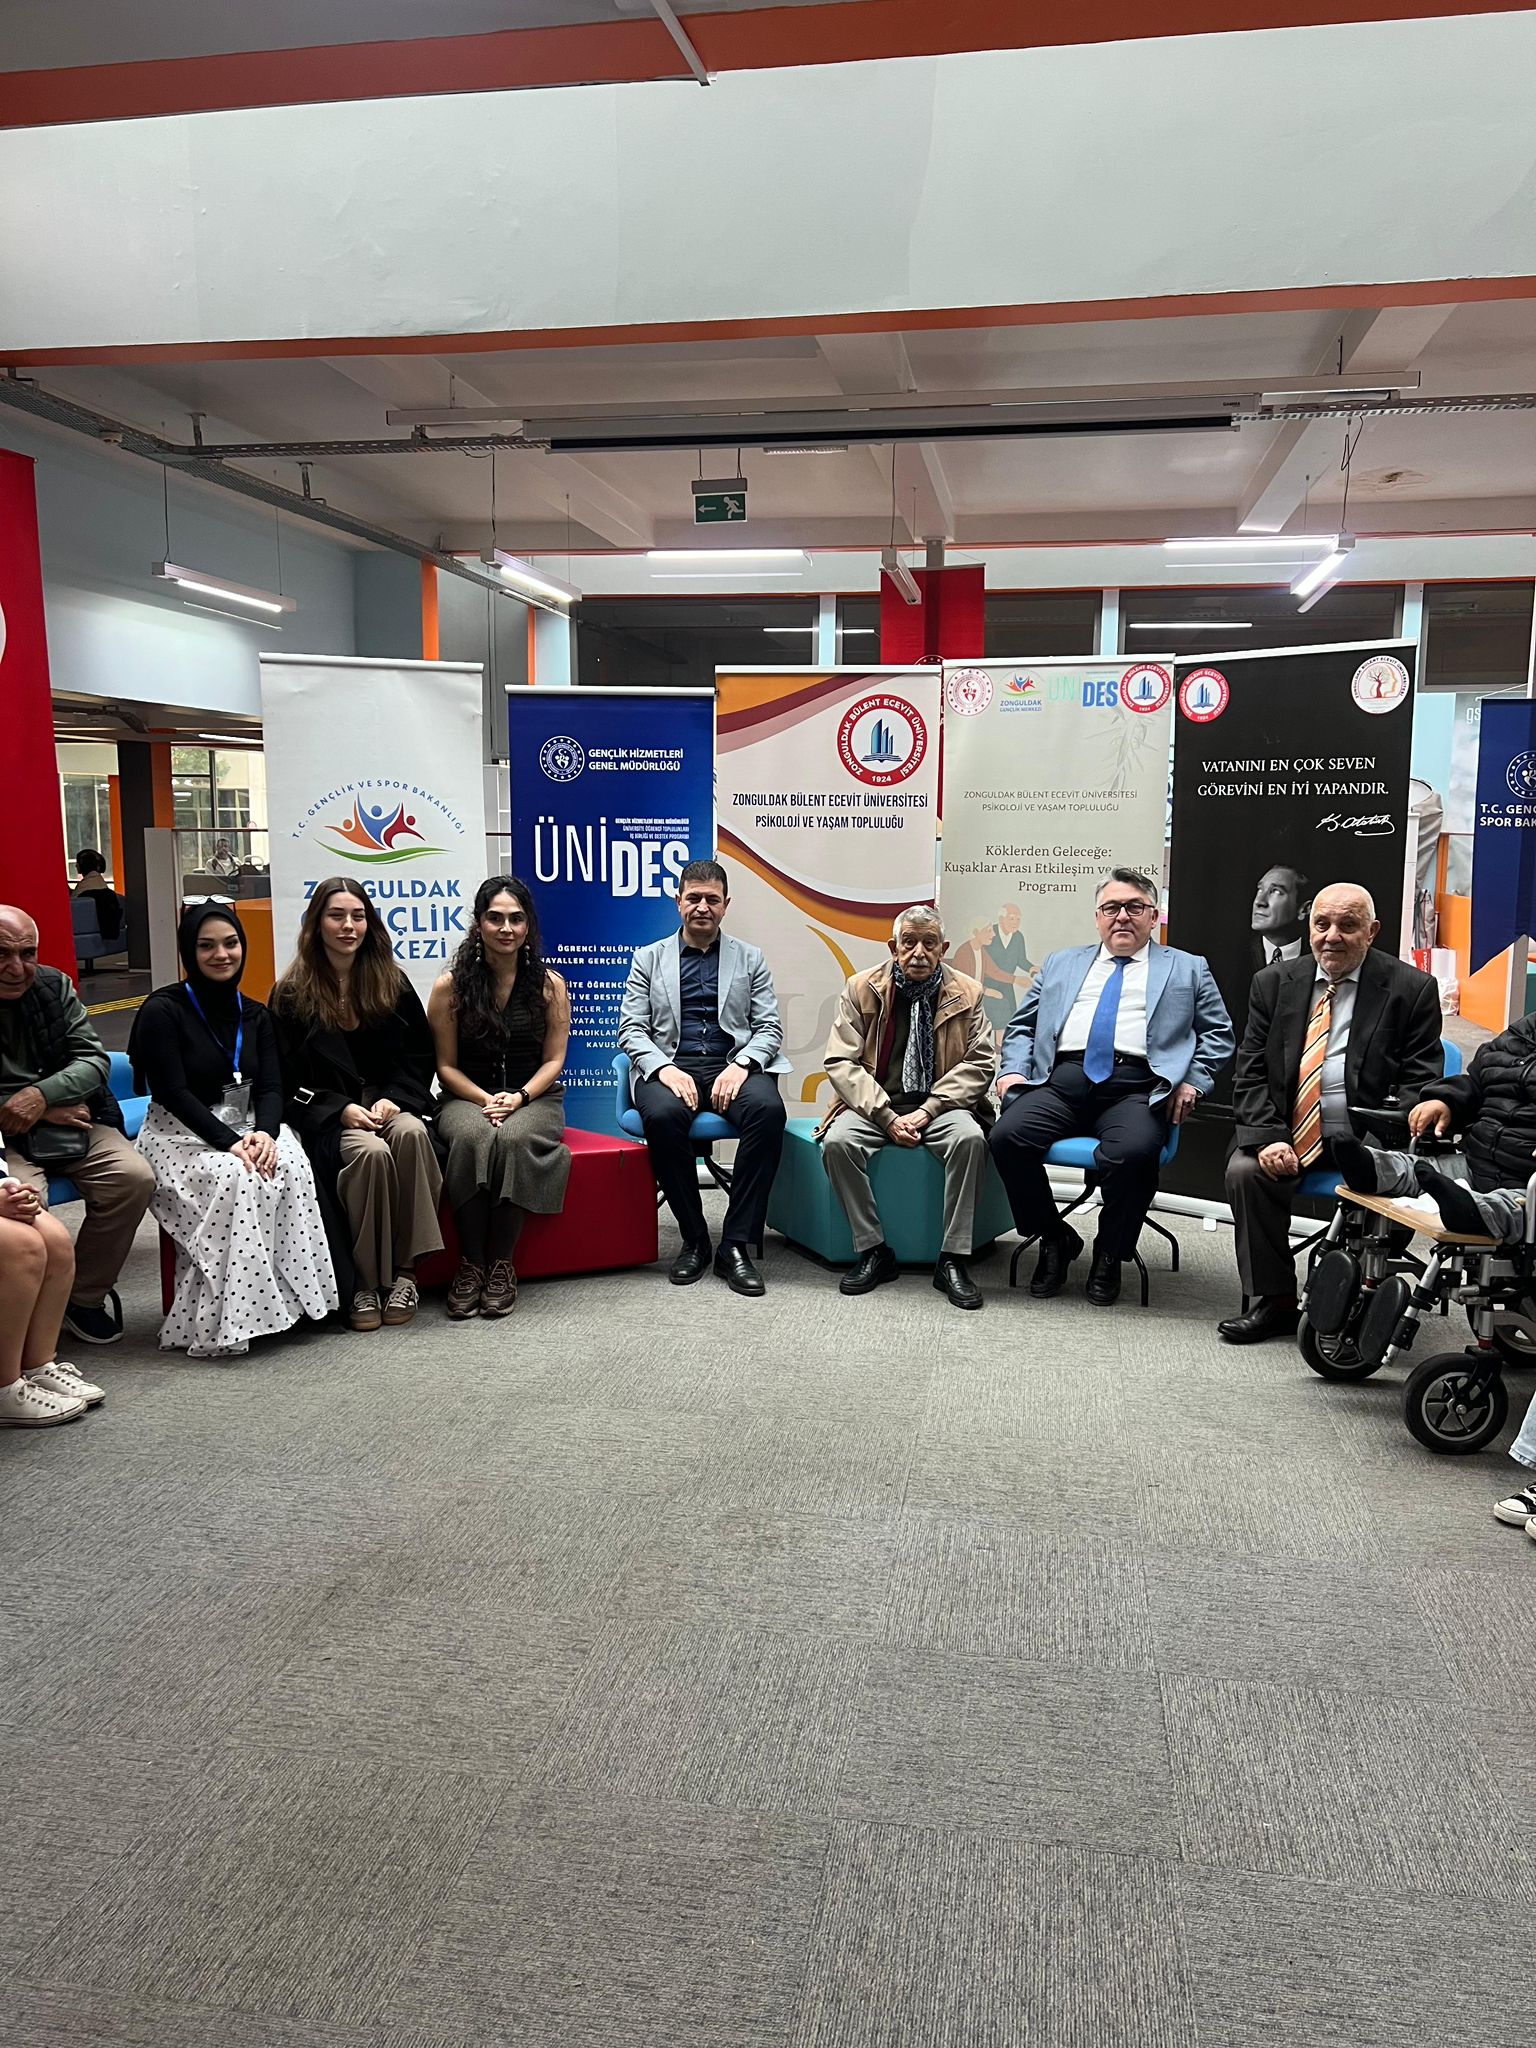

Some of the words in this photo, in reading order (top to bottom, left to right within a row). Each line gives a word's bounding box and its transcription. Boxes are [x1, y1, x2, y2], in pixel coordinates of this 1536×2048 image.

[1083, 681, 1119, 707] DES
[849, 698, 880, 721] BÜLENT
[883, 698, 914, 717] ECEVİT
[588, 748, 628, 760] GENÇLİK
[630, 748, 683, 759] HİZMETLERİ
[841, 721, 864, 776] ZONGULDAK
[900, 716, 924, 778] ÜNİVERSİTESİ
[588, 762, 618, 771] GENEL
[620, 760, 681, 771] MÜDÜRLÜĞÜ
[1202, 759, 1266, 773] VATANINI
[1269, 759, 1290, 772] EN
[1293, 758, 1325, 773] ÇOK
[1328, 757, 1376, 770] SEVEN
[871, 775, 892, 783] 1924
[964, 790, 1015, 799] ZONGULDAK
[1017, 789, 1049, 798] BÜLENT
[1051, 789, 1080, 798] ECEVİT
[1082, 789, 1138, 799] ÜNİVERSİTESİ
[1197, 781, 1264, 796] GÖREVİNİ
[1267, 783, 1287, 795] EN
[1291, 781, 1310, 795] İYİ
[1314, 782, 1389, 795] YAPANDIR.
[308, 784, 355, 817] GENÇLİK
[358, 780, 372, 789] VE
[377, 780, 408, 791] SPOR
[733, 793, 788, 807] ZONGULDAK
[790, 792, 827, 807] BÜLENT
[829, 793, 861, 807] ECEVİT
[863, 792, 928, 808] ÜNİVERSİTESİ
[982, 802, 1023, 811] PSİKOLOJİ
[1037, 804, 1066, 812] YAŞAM
[1069, 802, 1119, 811] TOPLULUĞU
[1480, 804, 1502, 814] T.C.
[755, 813, 800, 828] PSİKOLOJİ
[802, 816, 814, 828] VE
[817, 816, 849, 830] YAŞAM
[851, 814, 904, 829] TOPLULUĞU
[1480, 816, 1512, 827] SPOR
[985, 845, 1049, 857] Köklerden
[1052, 845, 1112, 859] Geleceğe:
[944, 862, 997, 875] Kuşaklar
[999, 863, 1032, 874] Arası
[1035, 863, 1094, 877] Etkileşim
[1097, 866, 1111, 874] ve
[303, 880, 461, 899] ZGULDAK
[1018, 880, 1077, 894] Programı
[587, 956, 628, 966] GERÇEĞE
[587, 980, 626, 989] ÖĞRENCİ
